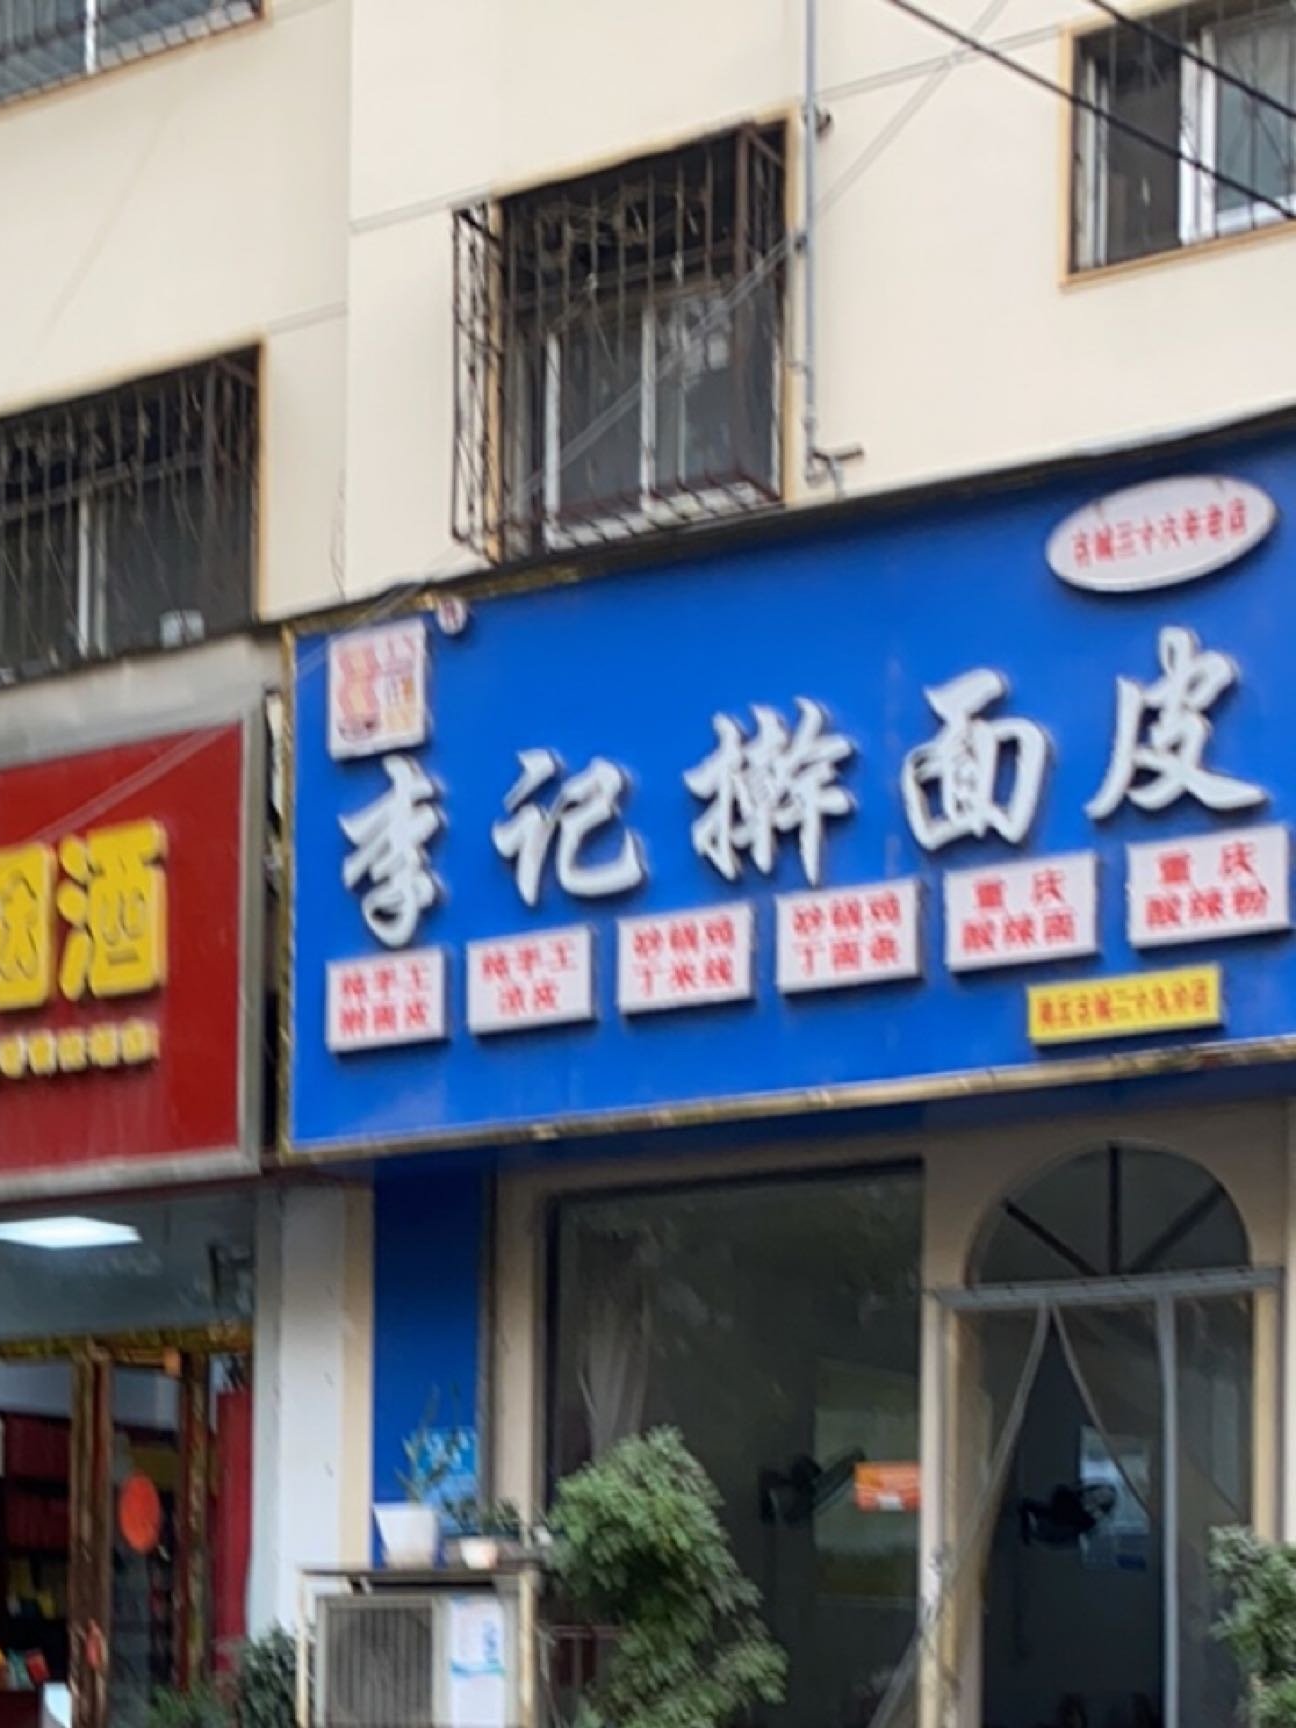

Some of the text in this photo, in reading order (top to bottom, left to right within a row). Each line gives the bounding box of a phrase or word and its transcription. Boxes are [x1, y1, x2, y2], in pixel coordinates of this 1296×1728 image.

[339, 627, 1269, 947] 李记擀面皮
[1159, 843, 1255, 883] 重庆
[975, 869, 1065, 911] 重庆
[1145, 884, 1268, 929] 酸辣粉
[962, 909, 1075, 953] 酸辣面
